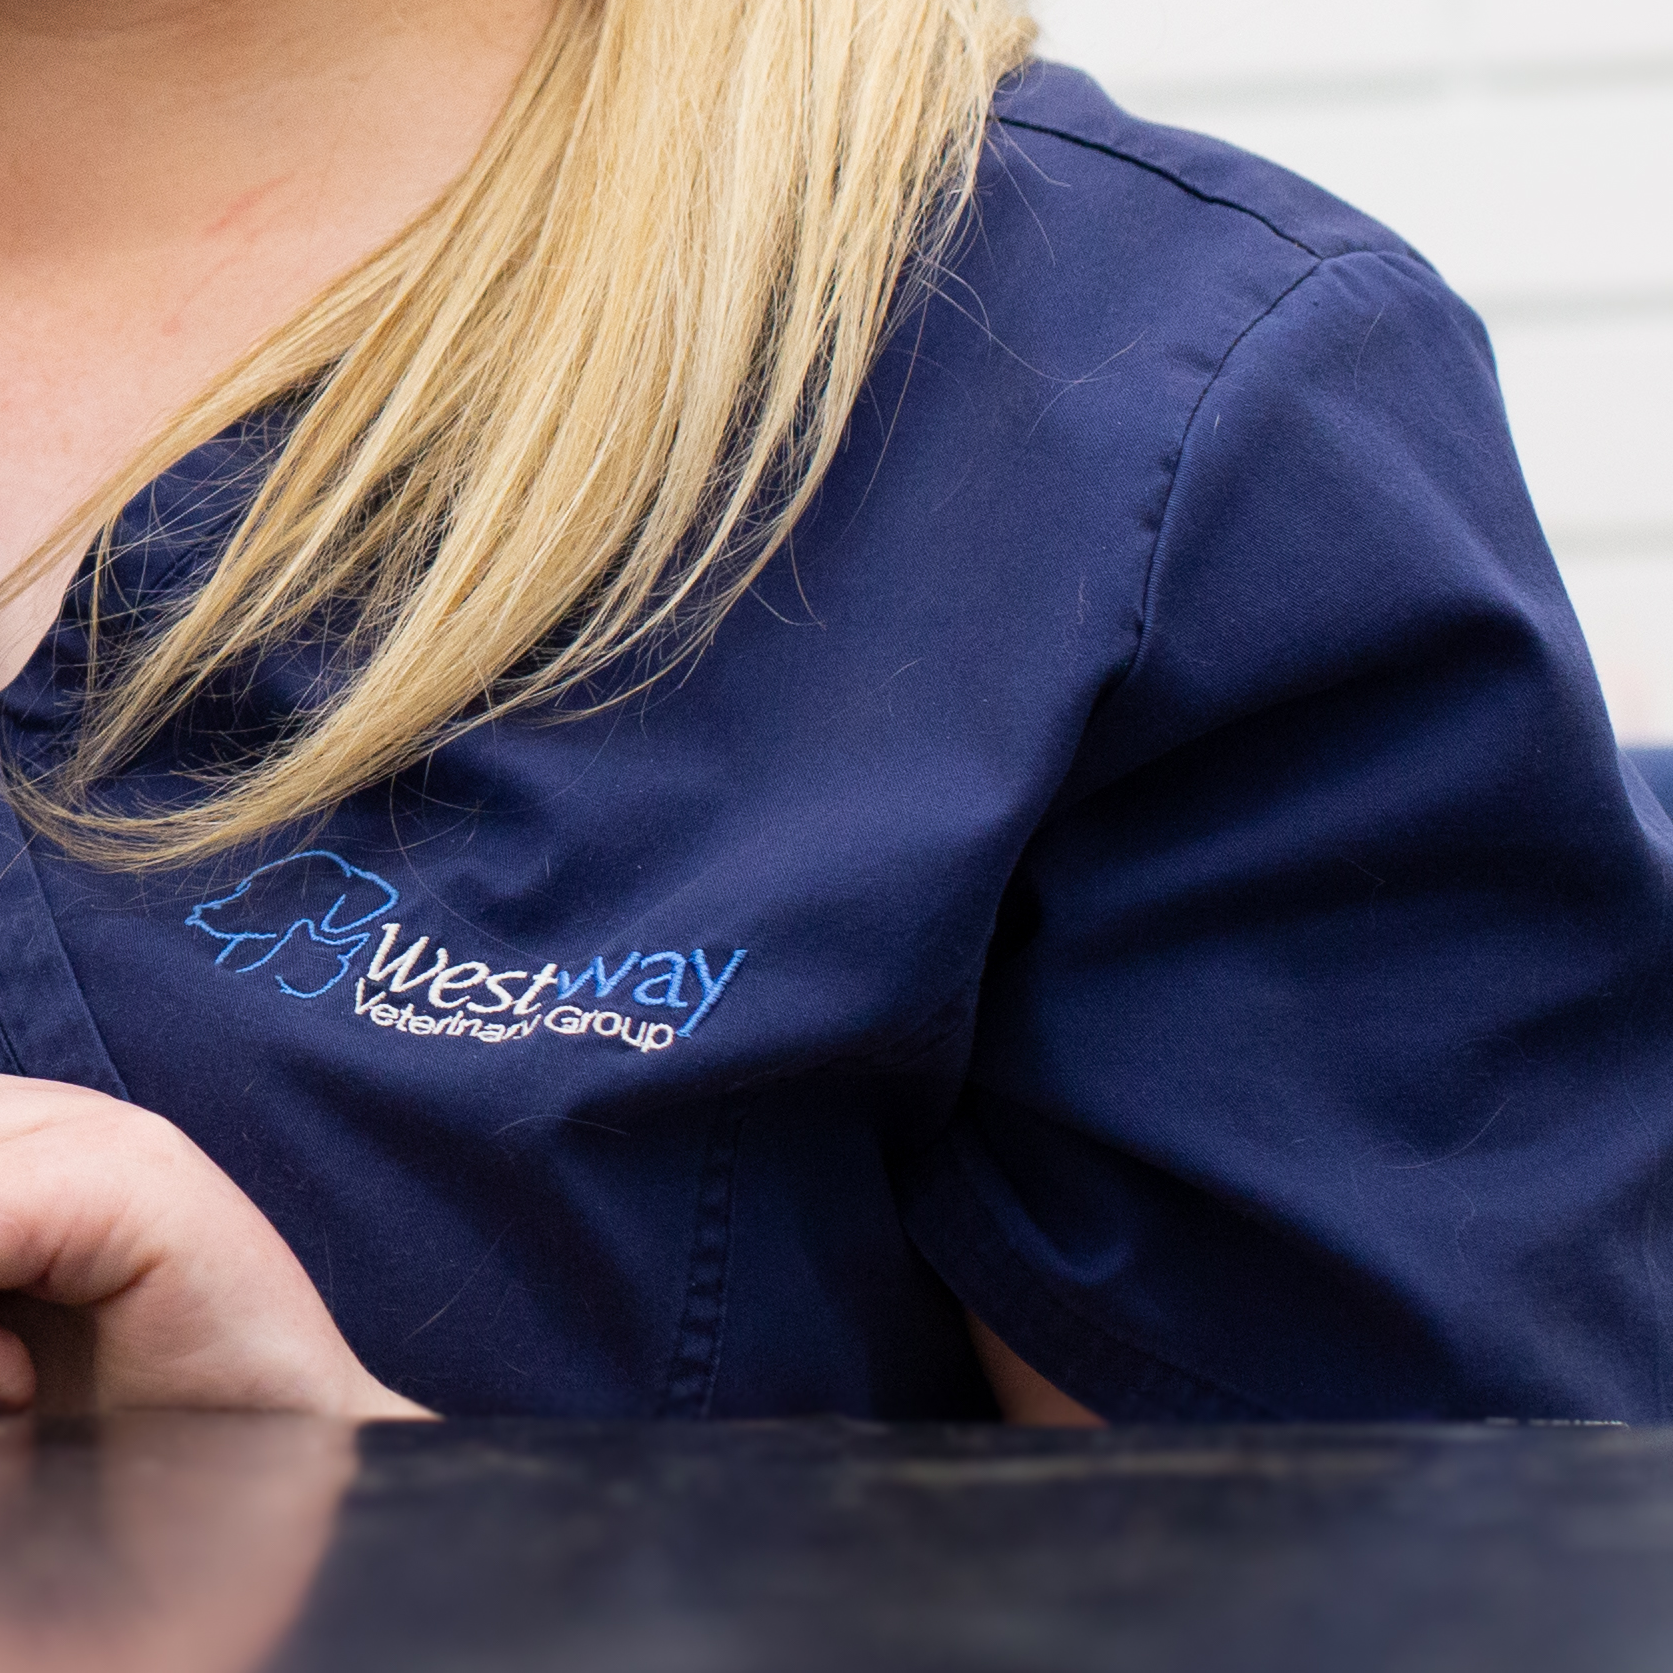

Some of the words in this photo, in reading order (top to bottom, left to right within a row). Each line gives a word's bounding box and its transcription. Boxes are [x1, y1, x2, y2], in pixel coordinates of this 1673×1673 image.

[354, 977, 542, 1043] Veterinary
[542, 1005, 674, 1052] Group
[368, 922, 749, 1038] Westway
